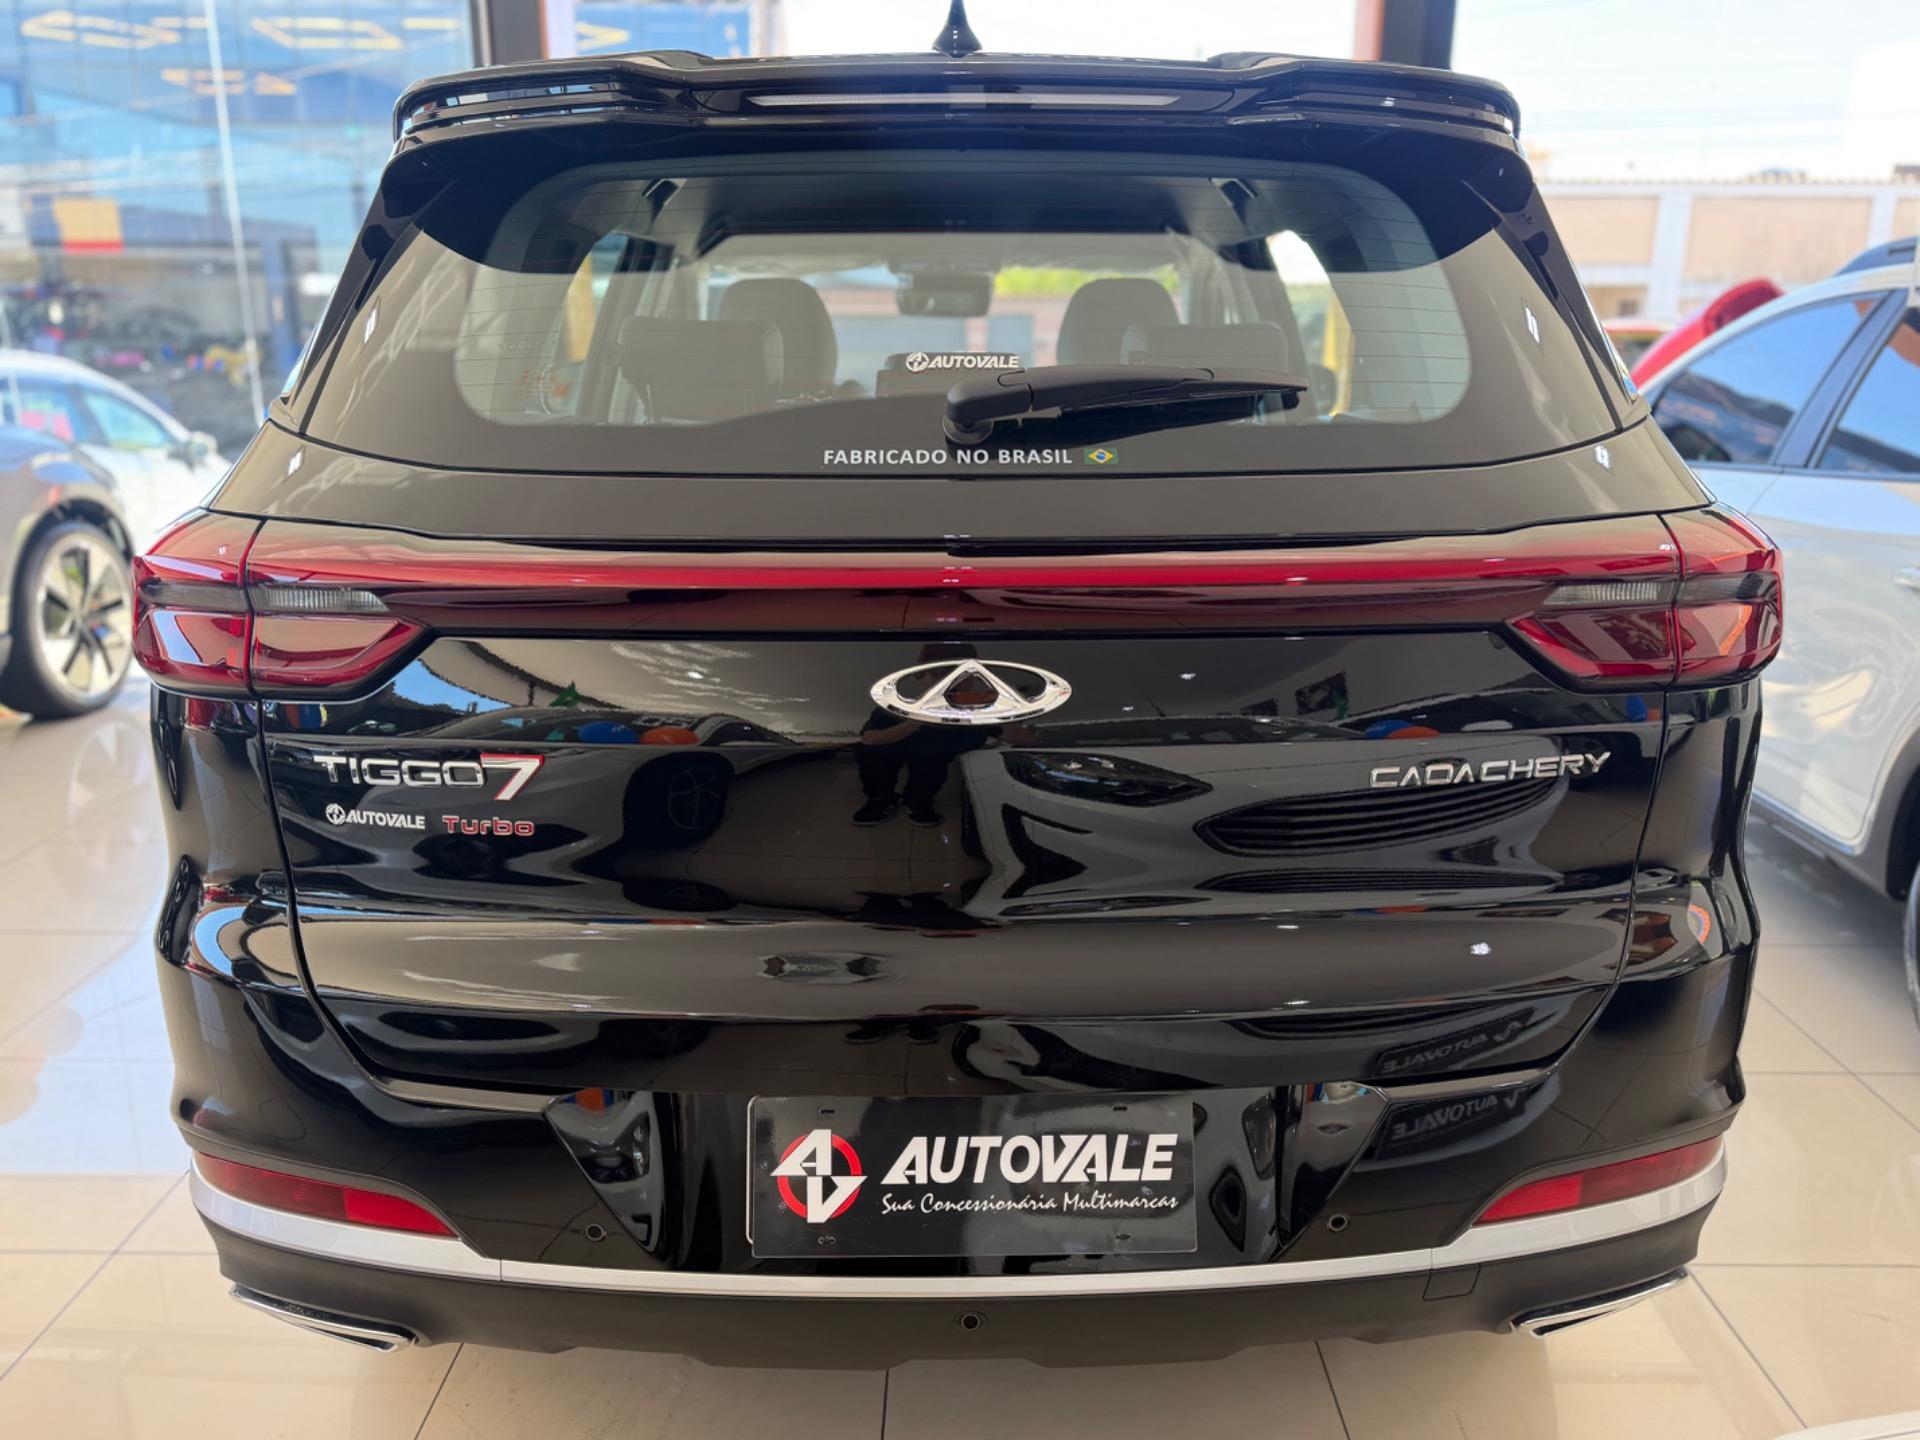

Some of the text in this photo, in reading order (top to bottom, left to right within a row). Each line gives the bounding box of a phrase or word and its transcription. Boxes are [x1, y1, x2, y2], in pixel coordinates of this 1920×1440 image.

[928, 355, 1020, 369] AUTOVALE
[823, 449, 1073, 465] FABRICADO NO BRASIL
[1481, 751, 1612, 782] CHERY
[345, 809, 426, 830] AUTOVALE
[442, 815, 535, 836] Turbo
[880, 1133, 1179, 1185] AUTOVALE
[881, 1188, 1179, 1215] Sua Concessionária Multimarcas
